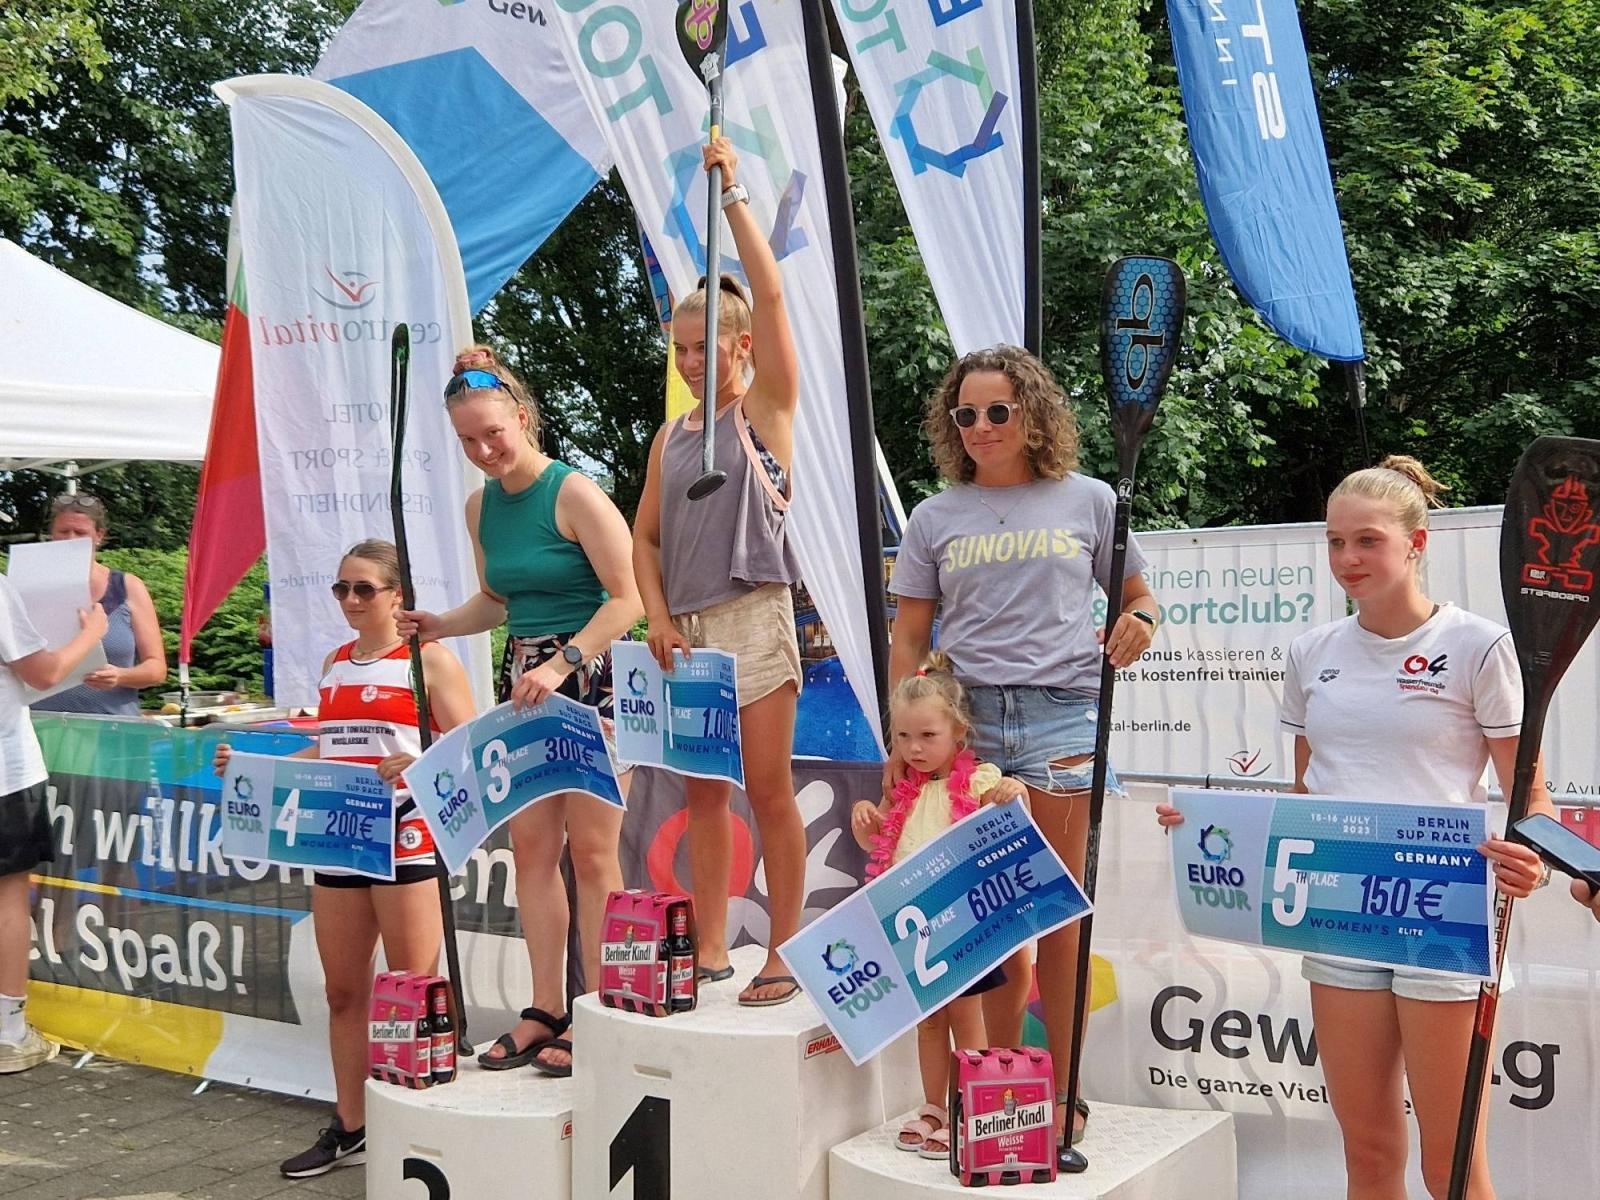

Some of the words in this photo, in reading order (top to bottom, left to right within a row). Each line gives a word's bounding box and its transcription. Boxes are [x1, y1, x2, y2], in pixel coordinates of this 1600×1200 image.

[945, 528, 1050, 574] SUNOVA
[1223, 565, 1313, 588] neuen
[1187, 647, 1265, 663] kassieren
[1271, 646, 1283, 661] &
[1141, 666, 1225, 682] kostenfrei
[620, 698, 655, 716] EURO
[621, 715, 659, 735] TOUR
[507, 747, 529, 763] PLACE
[544, 736, 595, 767] 300€
[481, 738, 512, 804] 3
[227, 800, 260, 818] EURO
[275, 788, 300, 847] 4
[345, 798, 385, 811] GERMANY
[438, 788, 469, 827] EURO
[228, 816, 264, 835] TOUR
[325, 810, 376, 842] 200€
[444, 801, 478, 840] TOUR
[975, 810, 1014, 835] BERLIN
[1343, 815, 1371, 826] JULY
[1343, 825, 1371, 835] 2023
[1417, 816, 1471, 831] BERLIN
[968, 835, 989, 852] SUP
[991, 820, 1019, 841] RACE
[1396, 829, 1426, 841] SUP
[1431, 830, 1472, 844] RACE
[924, 852, 947, 870] JULY
[977, 836, 1030, 868] GERMANY
[1394, 851, 1473, 868] GERMANY
[1187, 863, 1245, 887] EURO
[1271, 838, 1316, 927] 5
[1309, 873, 1340, 888] PLACE
[967, 858, 1042, 923] 600€
[1189, 885, 1252, 911] TOUR
[1360, 873, 1450, 922] 150€
[932, 906, 957, 933] PLACE
[952, 913, 1014, 962] WOMEN'S
[1016, 901, 1035, 915] ELITE
[1310, 916, 1390, 936] WOMEN'S
[1398, 926, 1424, 937] ELITE
[76, 903, 248, 995] Spaß!
[605, 945, 631, 962] Berliner
[632, 945, 651, 961] Kindl
[895, 905, 949, 988] 2
[827, 961, 882, 1005] EURO
[838, 975, 898, 1019] TOUR
[1149, 1066, 1188, 1089] Die
[1197, 1075, 1273, 1097] ganze
[975, 1114, 1016, 1137] Berliner
[1017, 1105, 1046, 1127] Kindl
[610, 1095, 671, 1200] 1
[997, 1135, 1025, 1148] Weisse
